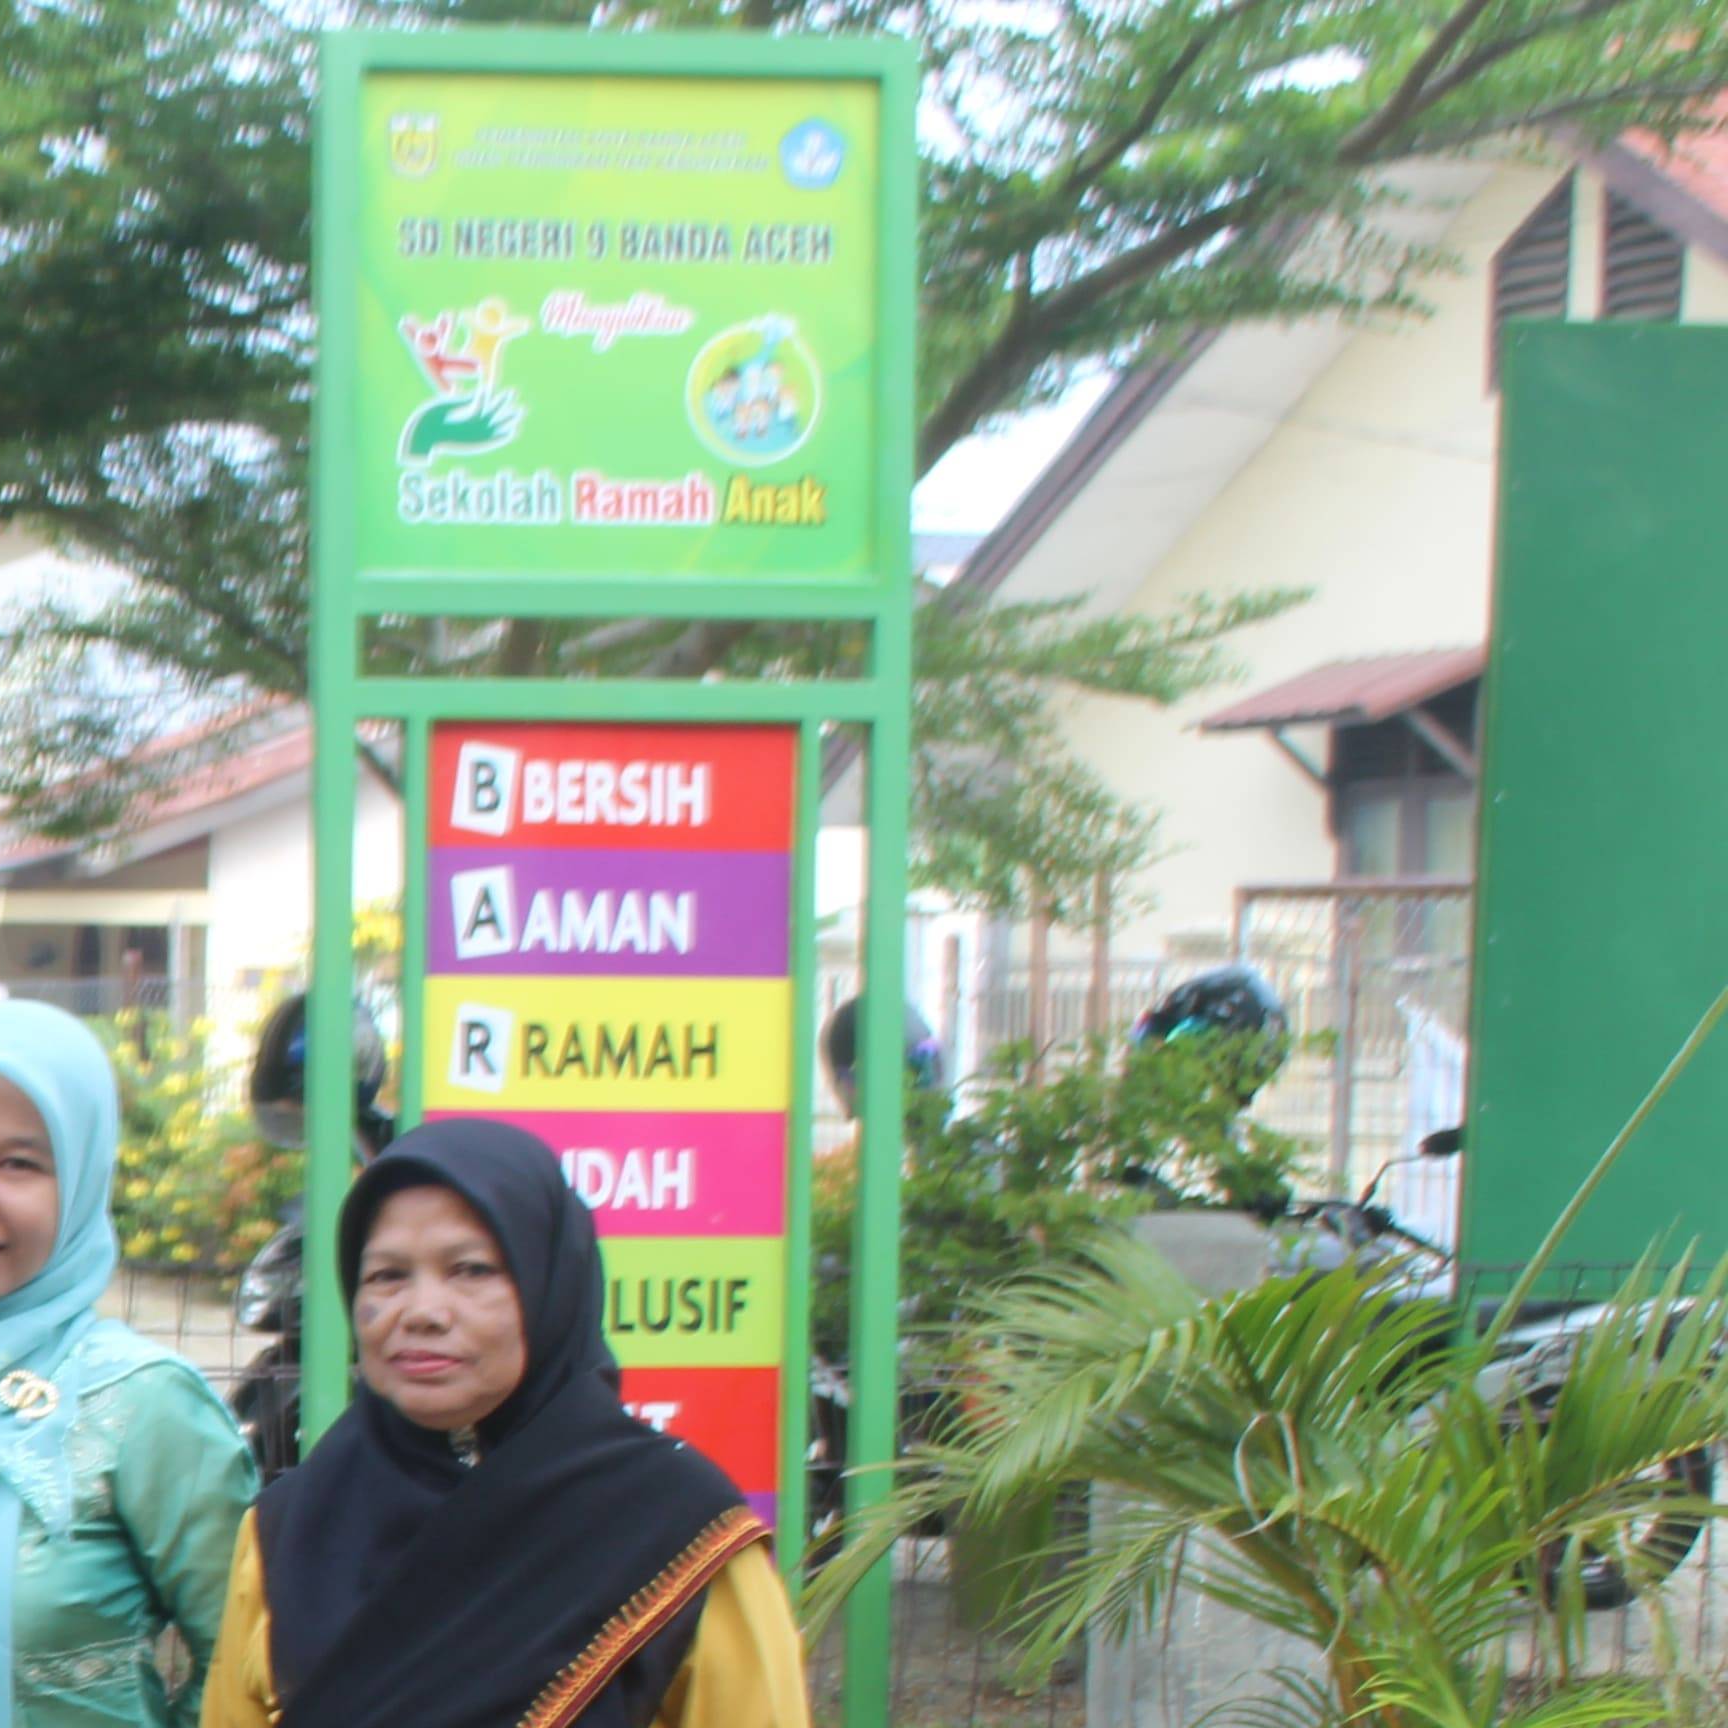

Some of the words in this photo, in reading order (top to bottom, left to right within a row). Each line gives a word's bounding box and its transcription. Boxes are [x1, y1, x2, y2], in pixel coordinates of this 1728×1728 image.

[398, 218, 440, 259] SD
[453, 219, 574, 261] NEGERI
[586, 220, 606, 261] 9
[620, 221, 731, 262] BANDA
[743, 224, 833, 264] ACEH
[398, 470, 562, 523] Sekolah
[571, 470, 715, 525] Ramah
[722, 474, 827, 525] Anak
[523, 759, 709, 828] BERSIH
[519, 889, 697, 955] AMAN
[520, 1021, 720, 1080] RAMAH
[609, 1276, 750, 1335] LUSIF
